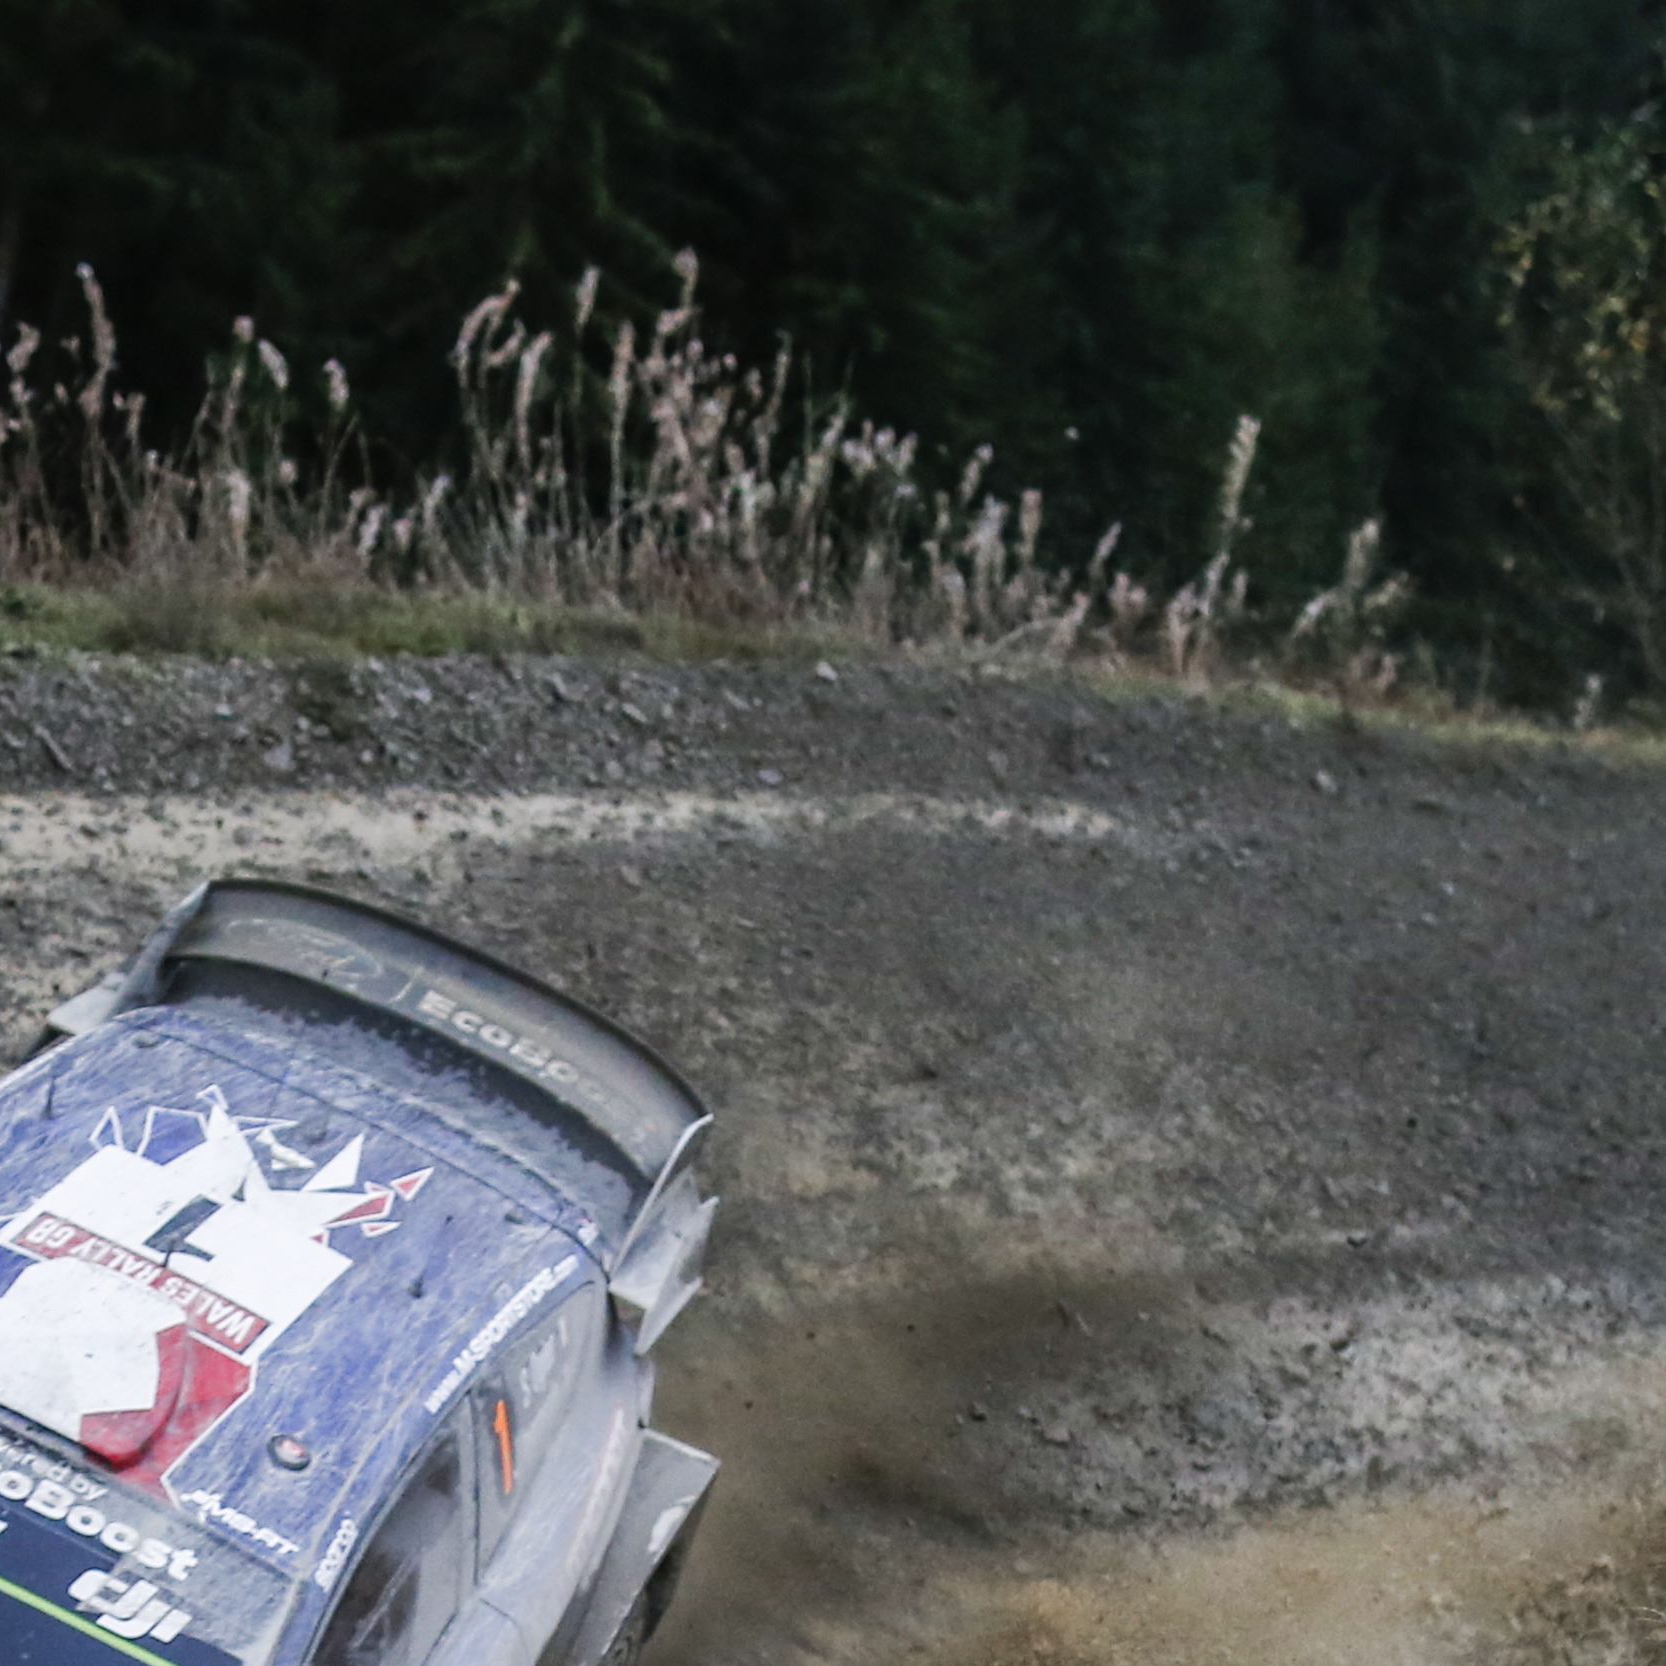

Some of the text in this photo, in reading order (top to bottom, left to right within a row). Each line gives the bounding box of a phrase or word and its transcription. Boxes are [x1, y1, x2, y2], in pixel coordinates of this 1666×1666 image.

[69, 1237, 163, 1291] RALLY
[160, 1276, 256, 1344] WALES
[493, 1399, 514, 1495] 1
[70, 1470, 110, 1502] by
